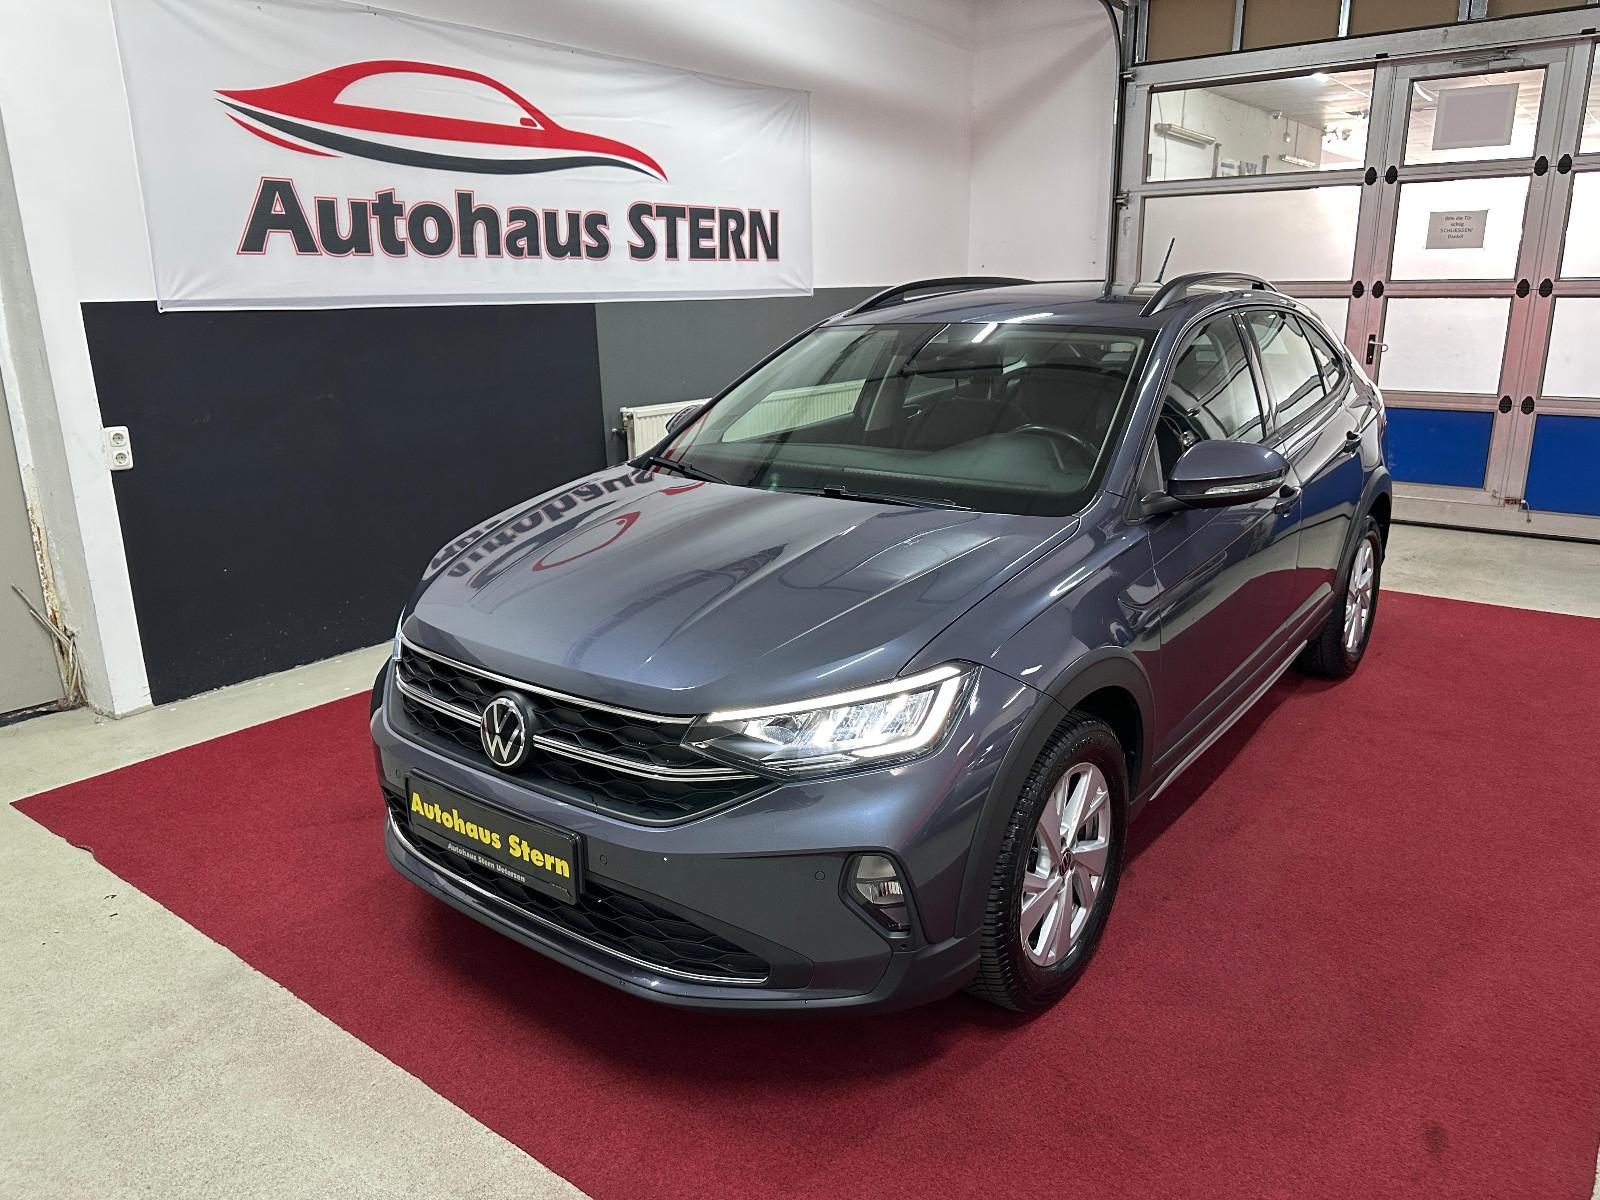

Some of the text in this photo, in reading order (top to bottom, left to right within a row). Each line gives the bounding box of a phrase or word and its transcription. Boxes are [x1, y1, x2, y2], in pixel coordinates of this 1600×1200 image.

[237, 176, 780, 262] Autohaus STERN
[410, 791, 570, 878] Autohaus Stern
[447, 843, 526, 883] Autohaus Stern Uetersen
